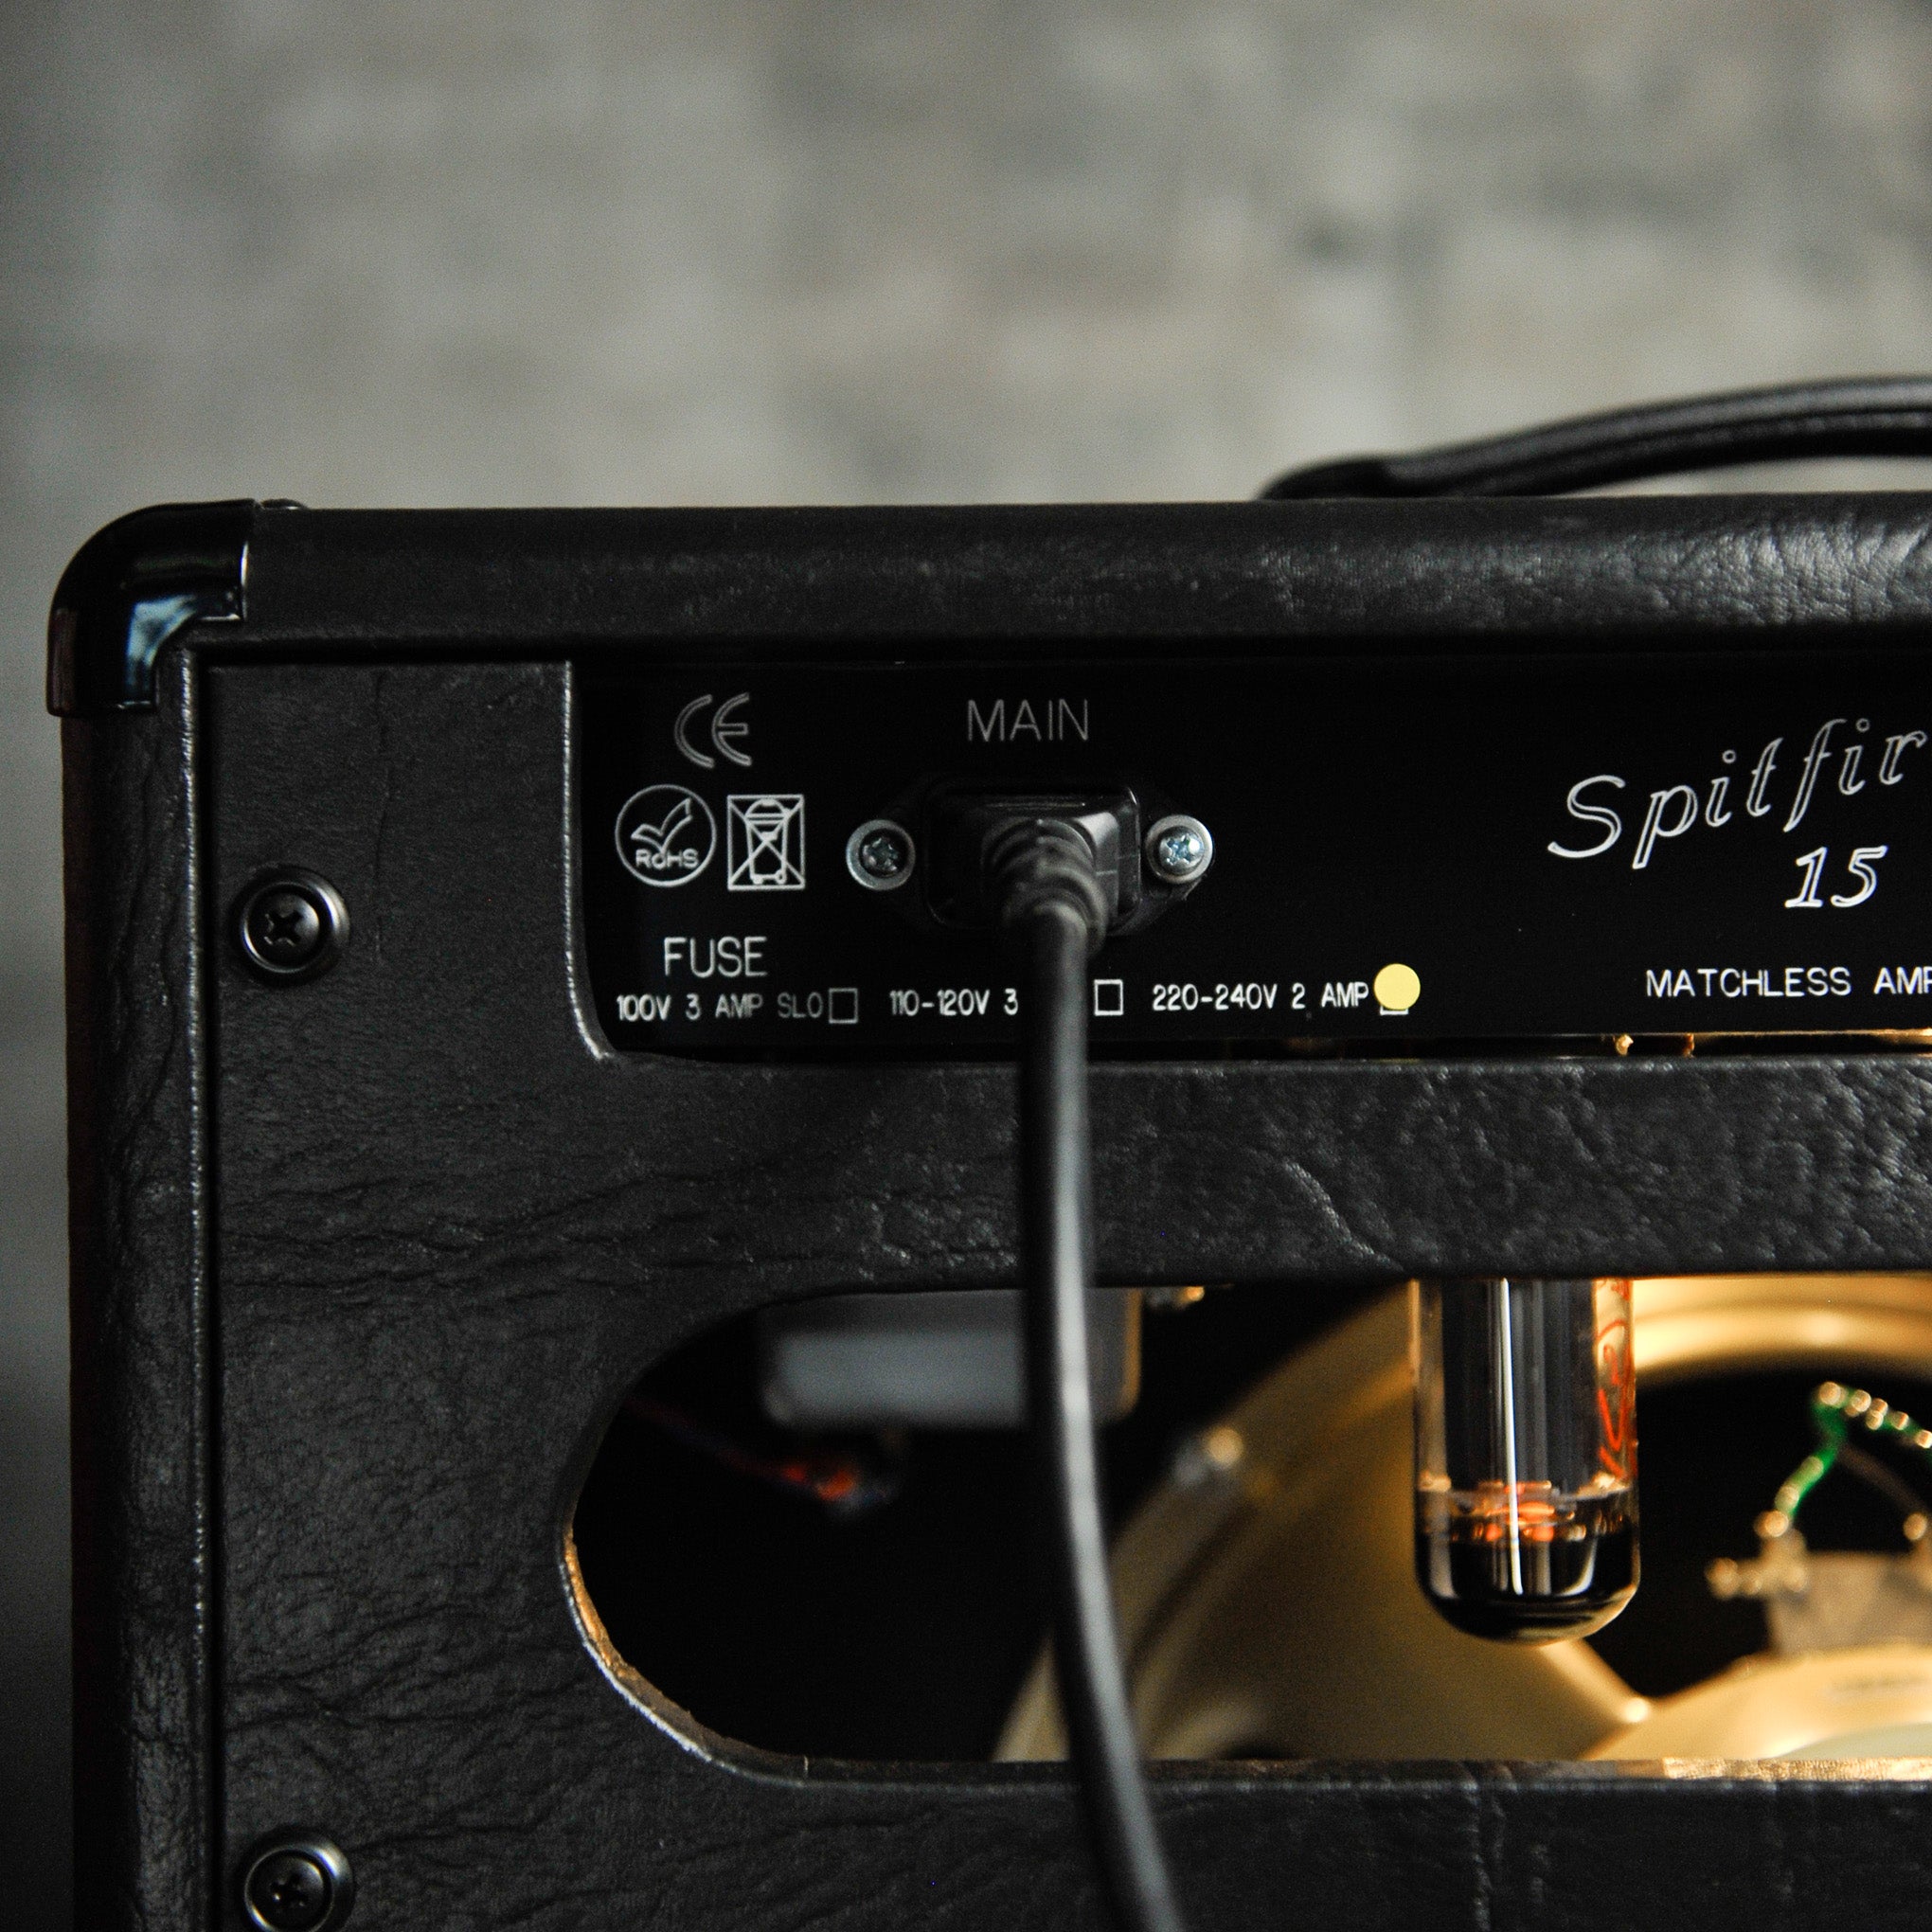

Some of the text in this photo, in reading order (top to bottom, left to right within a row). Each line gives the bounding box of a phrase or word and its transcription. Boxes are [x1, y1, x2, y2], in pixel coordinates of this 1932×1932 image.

[674, 692, 752, 768] CE
[968, 699, 1088, 742] MAIN
[1547, 718, 1928, 869] Spitfir
[1784, 845, 1887, 908] 15
[664, 937, 767, 978] FUSE
[889, 988, 1019, 1017] 110-120V 3
[1152, 981, 1369, 1011] 220-240V 2 AMP
[1646, 967, 1852, 998] MATCHLESS
[617, 992, 823, 1022] 100V 3 AMP SLO
